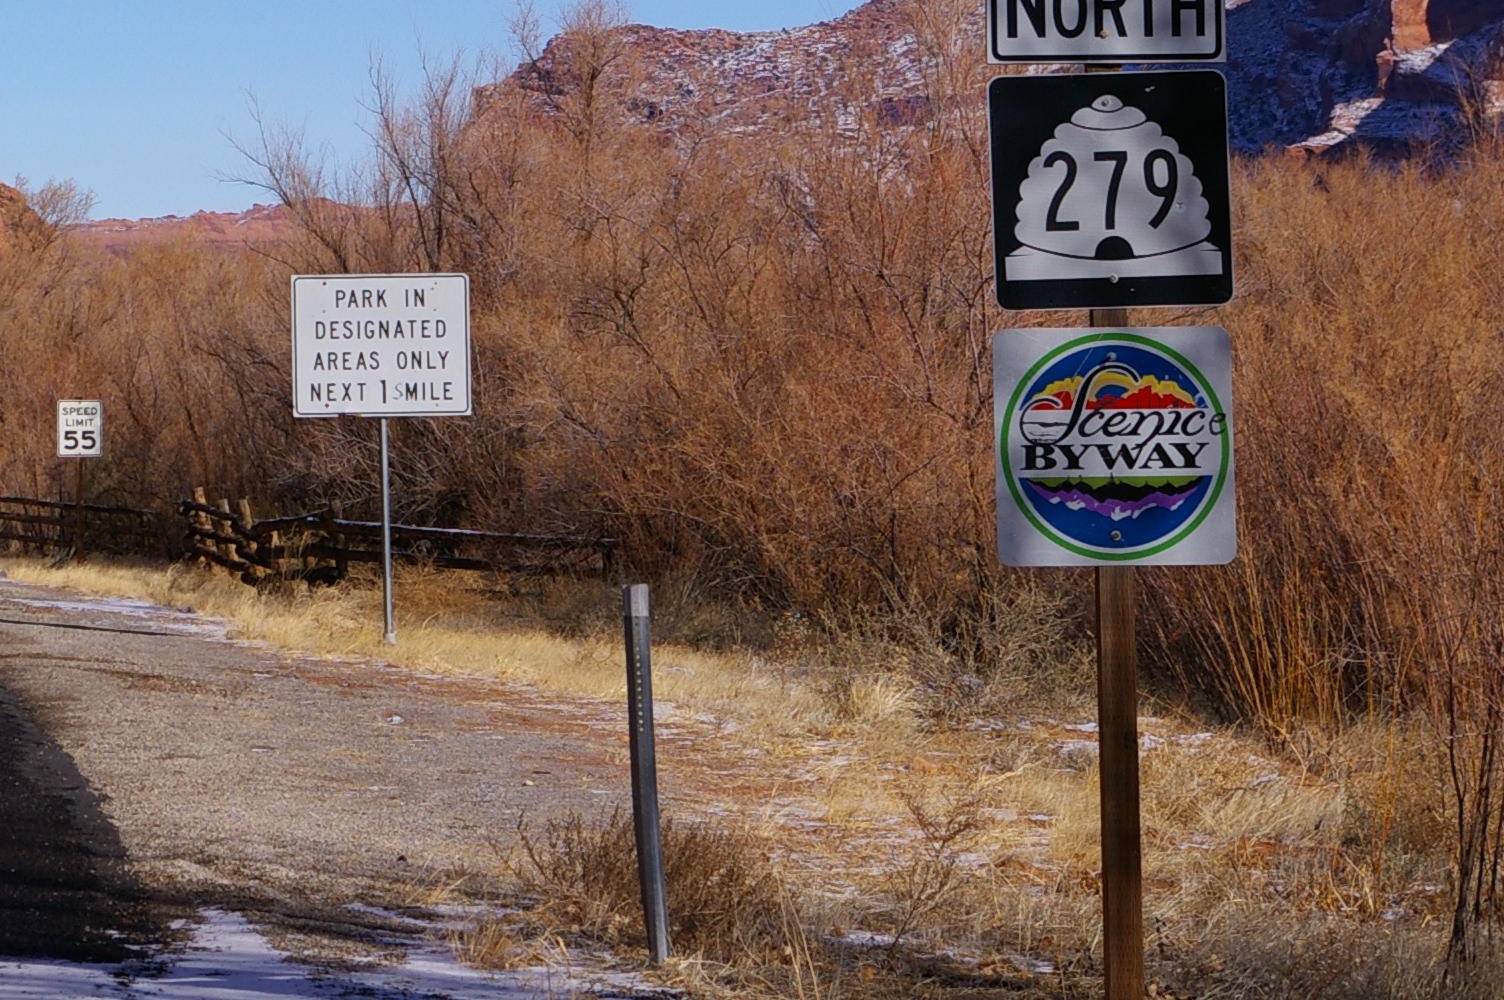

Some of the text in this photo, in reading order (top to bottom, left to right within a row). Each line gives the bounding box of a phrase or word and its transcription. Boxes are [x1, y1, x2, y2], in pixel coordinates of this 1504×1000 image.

[1042, 148, 1180, 233] 279
[335, 288, 425, 308] PARK IN
[315, 319, 447, 340] DESIGNATED
[313, 350, 449, 371] AREAS ONLY
[310, 382, 367, 402] NEXT
[379, 379, 387, 404] 1
[62, 407, 98, 416] SPEED
[65, 418, 94, 427] LIMIT
[64, 430, 96, 450] 55
[1019, 442, 1211, 471] BYWAY
